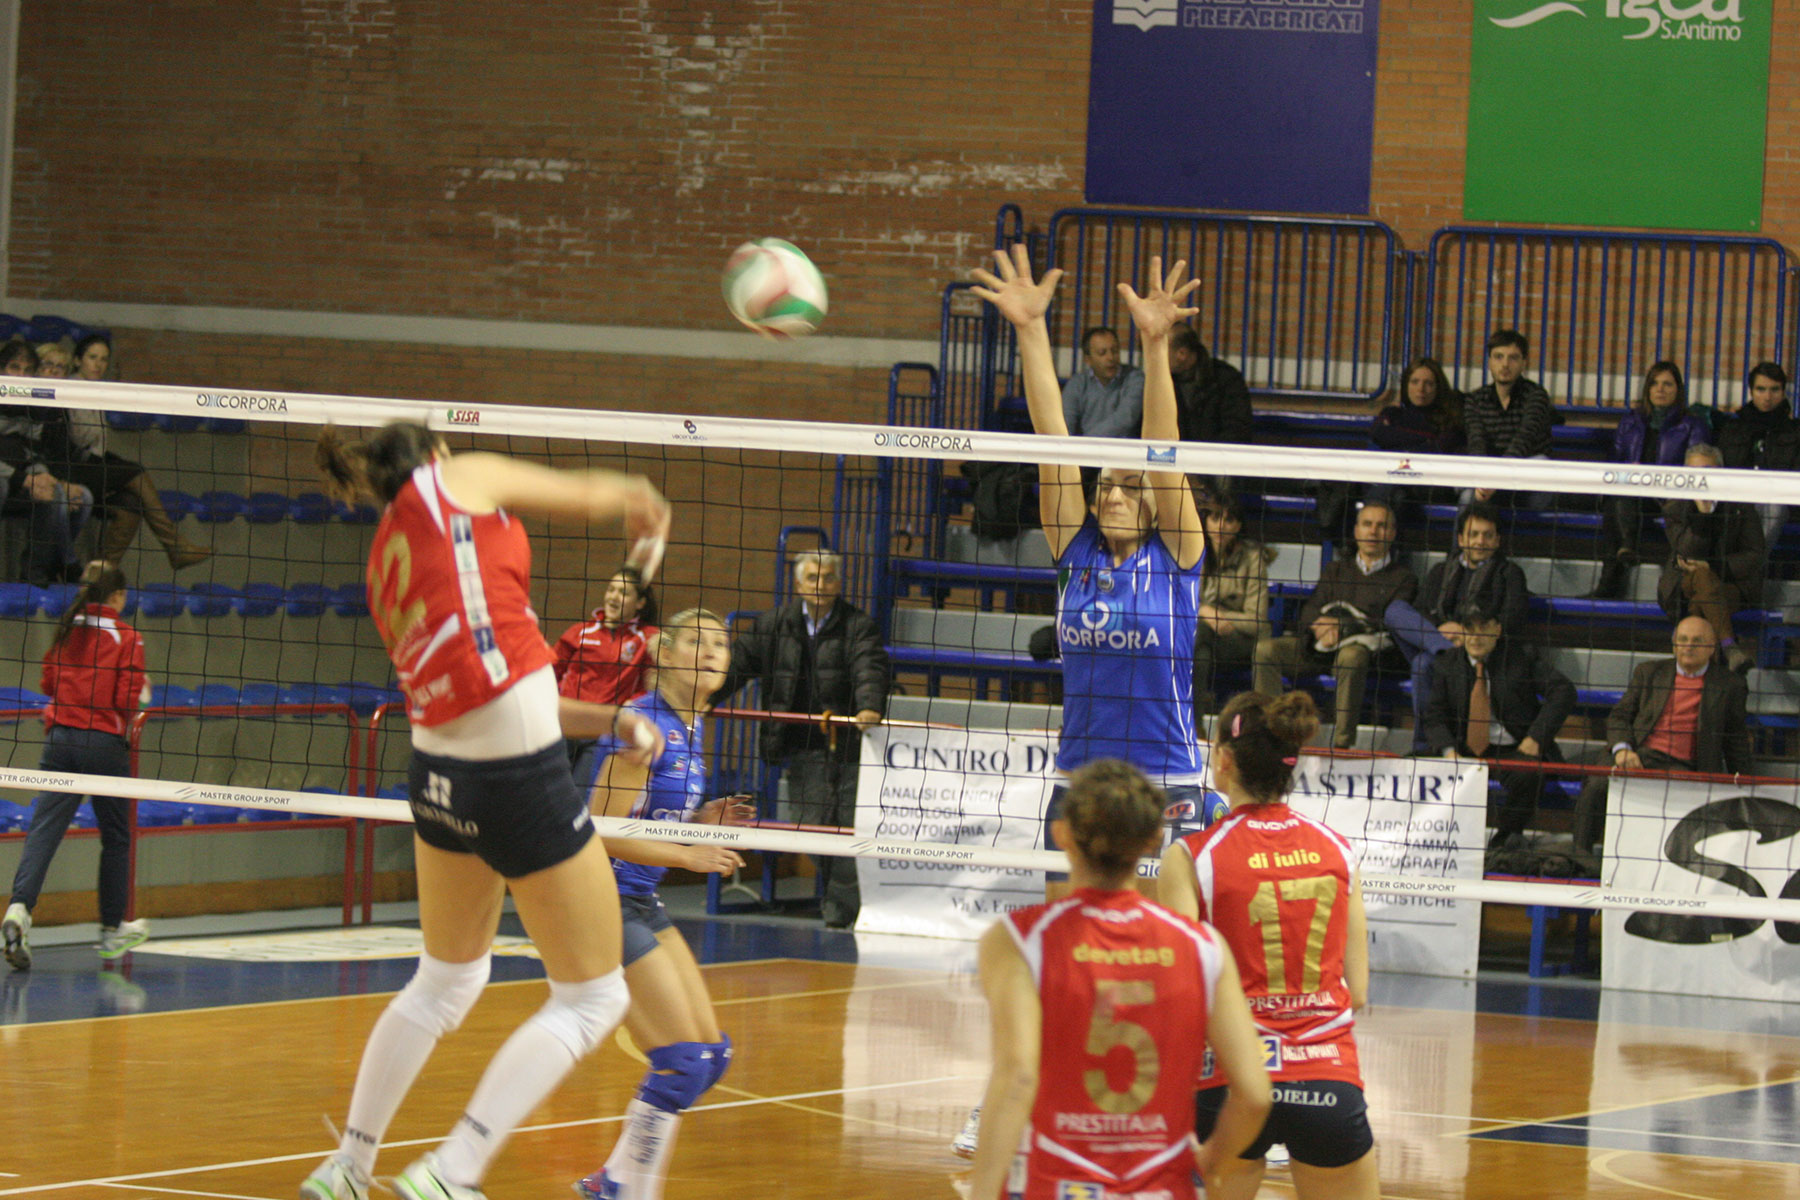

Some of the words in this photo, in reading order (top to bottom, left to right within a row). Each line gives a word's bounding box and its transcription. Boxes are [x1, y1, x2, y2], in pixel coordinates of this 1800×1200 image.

[1184, 7, 1363, 33] PREFABBRICATI
[1660, 19, 1742, 41] S.Antimo
[219, 395, 288, 412] CORPORA
[454, 410, 480, 423] SISA
[899, 434, 973, 451] CORPORA
[1629, 472, 1709, 489] CORPORA
[1062, 622, 1160, 649] CORPORA
[20, 776, 47, 784] GROUP
[49, 778, 75, 786] SPORT
[1295, 771, 1463, 802] ASTEUR”
[200, 791, 232, 800] MASTER
[234, 794, 263, 802] GROUP
[264, 796, 291, 805] SPORT
[645, 827, 679, 836] MASTER
[681, 830, 711, 838] GROUP
[713, 832, 740, 840] SPORT
[877, 846, 911, 855] MASTER
[913, 848, 944, 857] GROUP
[946, 850, 974, 859] SPORT
[1248, 853, 1269, 869] di
[1273, 848, 1321, 868] iulio
[1393, 881, 1426, 890] GROUP
[1427, 883, 1456, 892] SPORT
[1603, 895, 1640, 904] MASTER
[1642, 897, 1675, 906] GROUP
[1677, 899, 1707, 908] SPORT
[1248, 875, 1338, 994] 17
[1083, 979, 1160, 1114] 5
[1270, 1088, 1337, 1107] OIELLO
